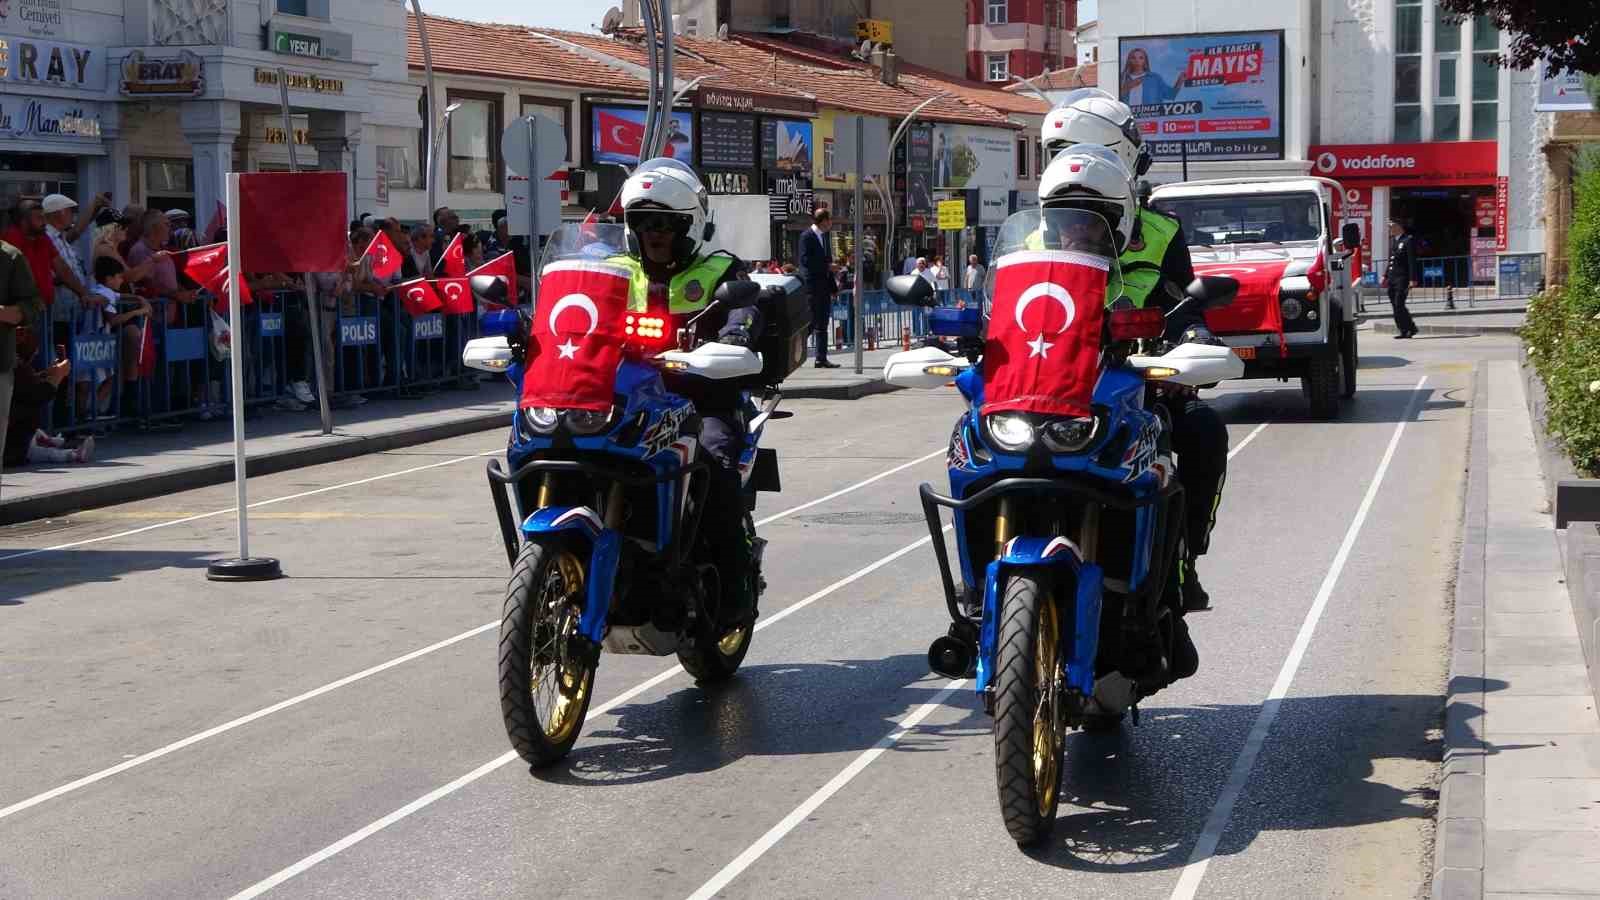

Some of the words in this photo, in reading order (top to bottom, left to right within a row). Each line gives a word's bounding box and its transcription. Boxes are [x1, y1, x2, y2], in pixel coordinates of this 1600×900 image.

[1192, 54, 1259, 78] MAYIS
[1163, 103, 1197, 115] YOK
[1214, 143, 1268, 154] mobilya
[1343, 155, 1415, 168] vodafone
[341, 320, 377, 343] POLİS
[415, 315, 443, 337] POLİS
[76, 340, 117, 361] YOZGAT
